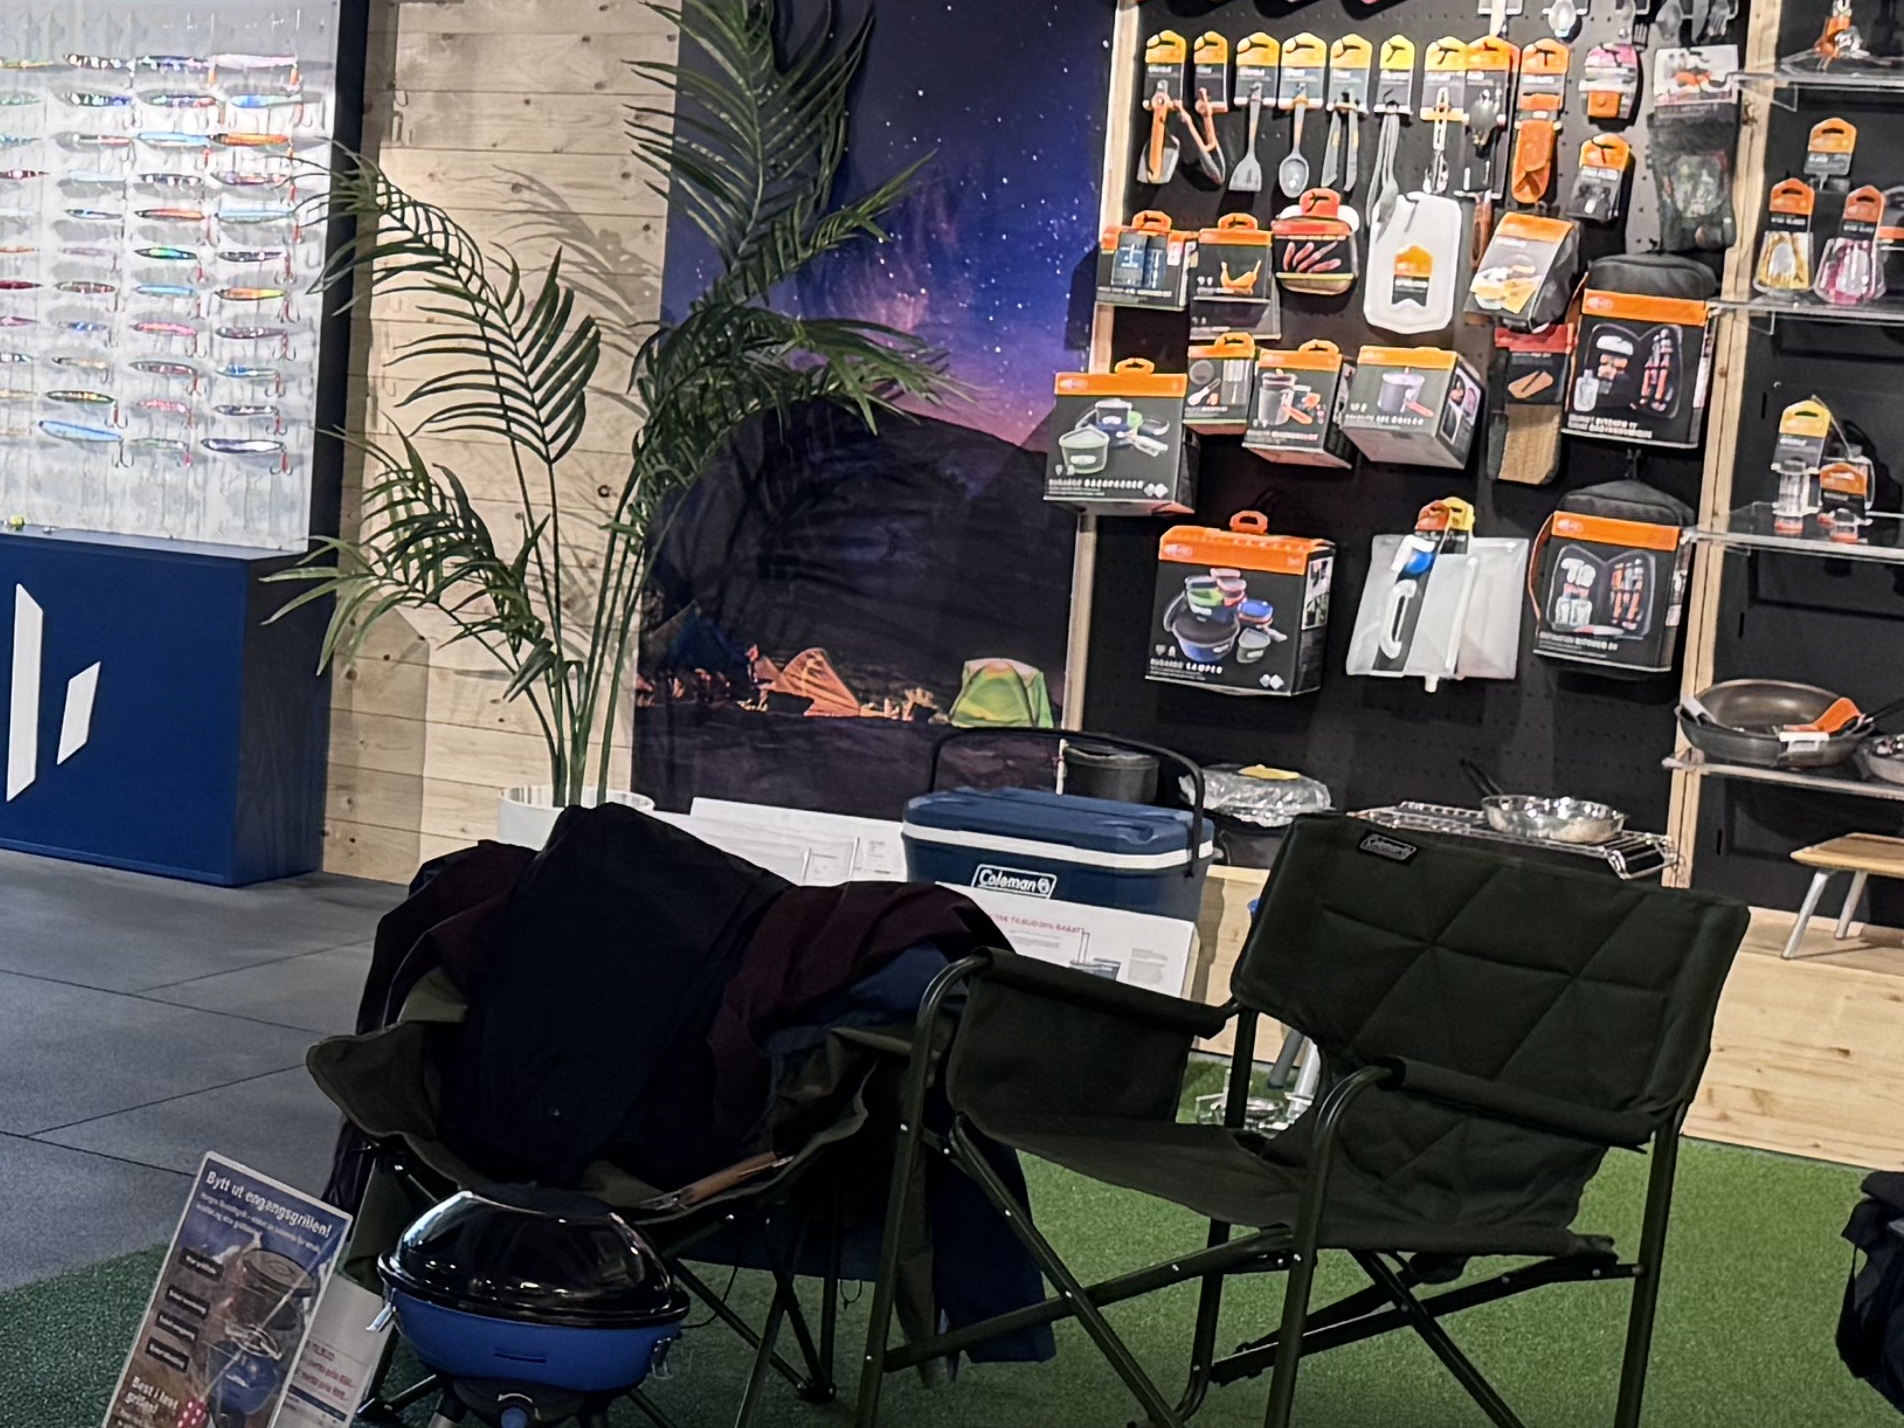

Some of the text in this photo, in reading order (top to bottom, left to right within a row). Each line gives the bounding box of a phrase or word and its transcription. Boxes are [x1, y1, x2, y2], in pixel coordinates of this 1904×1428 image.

[978, 868, 1036, 892] Coleman
[206, 1171, 230, 1191] Bytt
[231, 1182, 245, 1200] ut
[245, 1191, 333, 1238] engangsgrillen!
